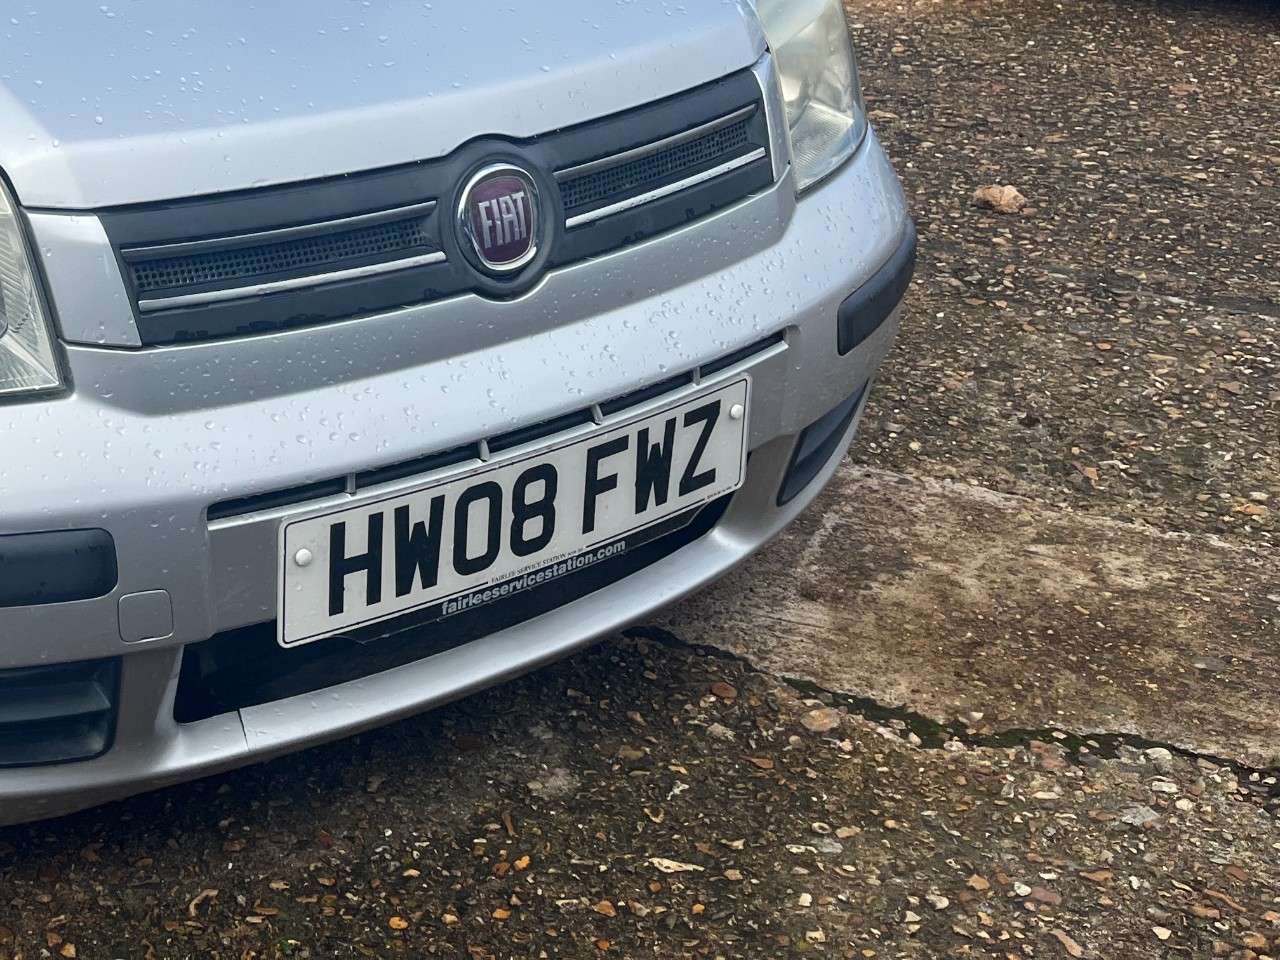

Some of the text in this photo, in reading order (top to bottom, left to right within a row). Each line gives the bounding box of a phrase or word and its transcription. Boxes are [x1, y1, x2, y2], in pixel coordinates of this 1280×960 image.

[478, 190, 526, 249] FIAT
[328, 399, 721, 617] HW08 FWZ
[441, 540, 627, 616] fairleeservicestation.com
[516, 561, 542, 577] SERVICE
[542, 552, 567, 566] STATION
